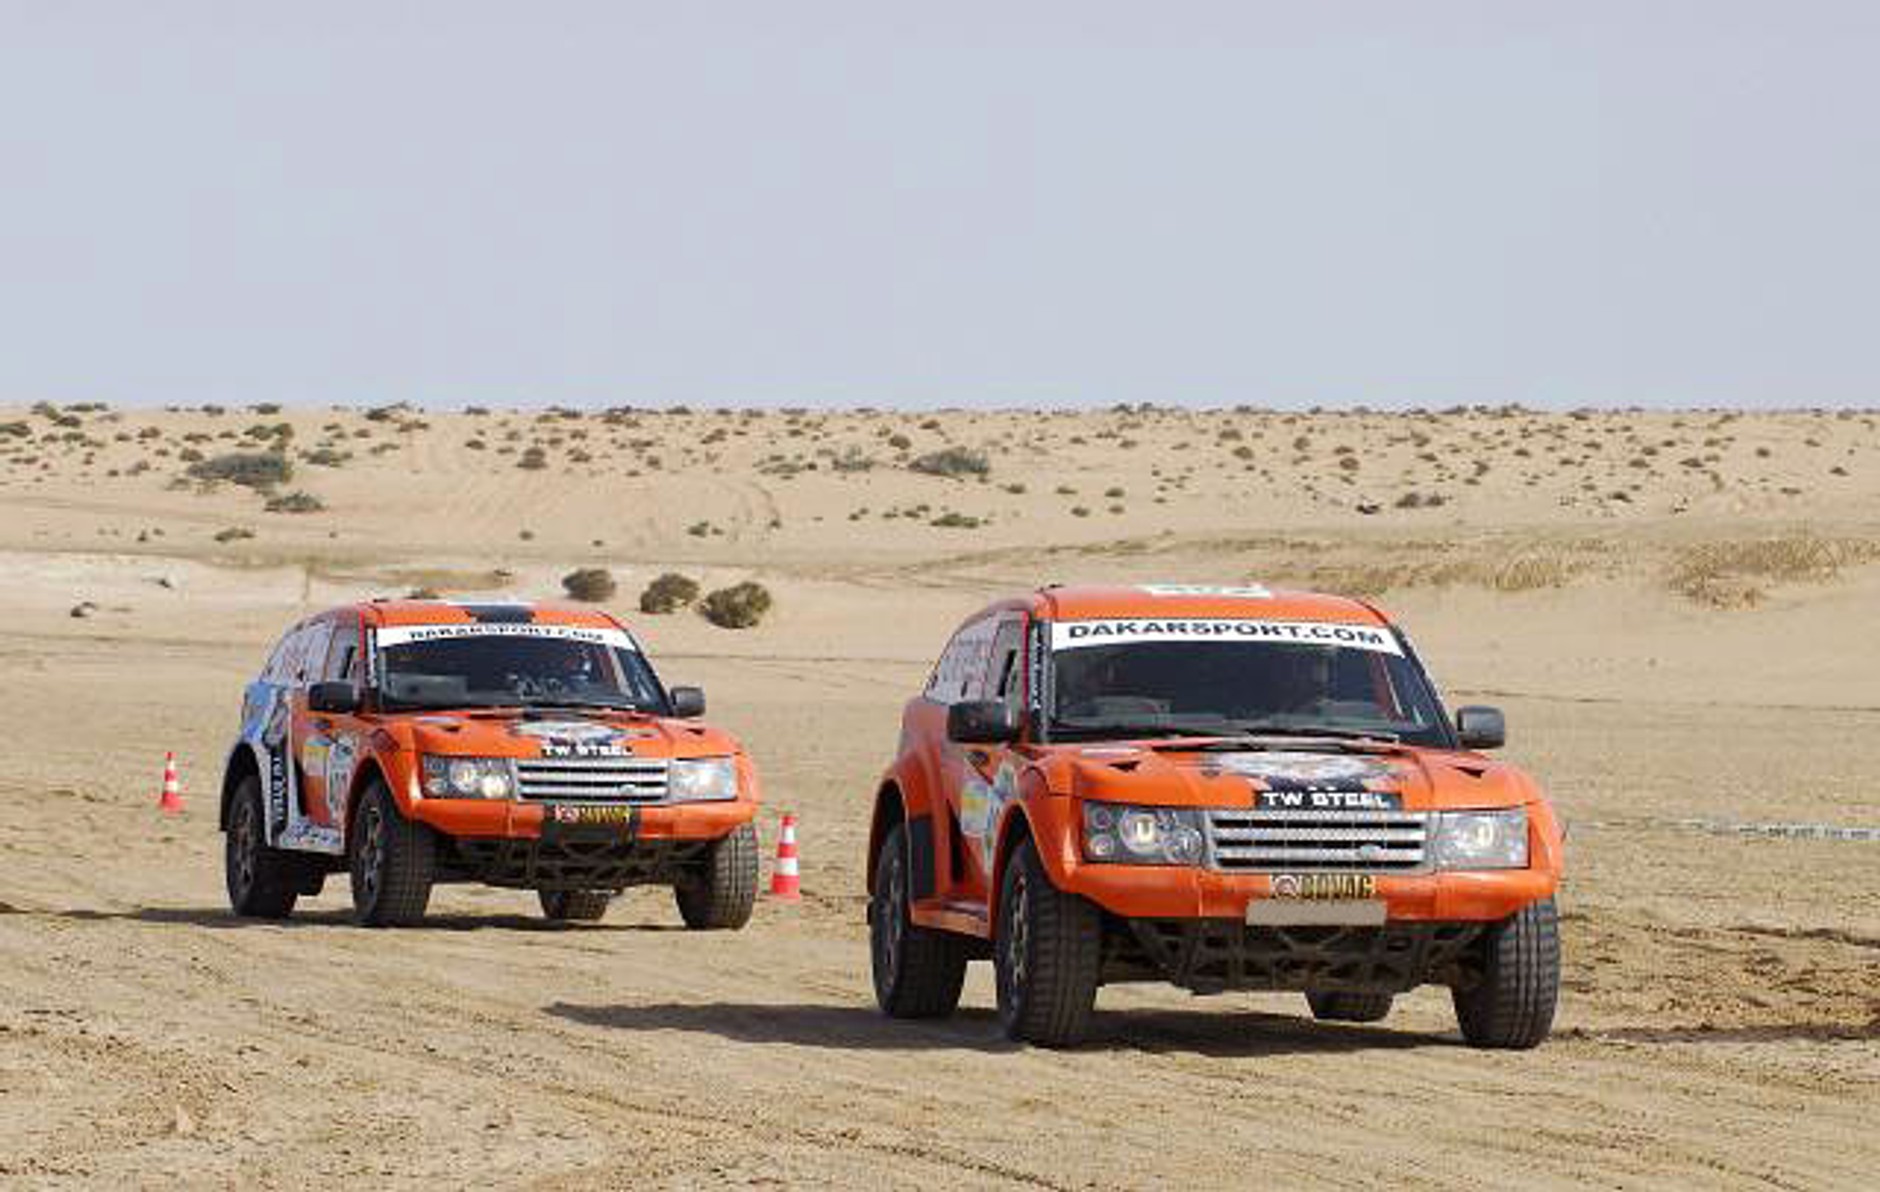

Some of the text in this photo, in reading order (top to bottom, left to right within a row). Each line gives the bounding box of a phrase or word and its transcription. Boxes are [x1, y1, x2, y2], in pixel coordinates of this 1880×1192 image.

[1068, 621, 1384, 646] DAKARSPORT.COM
[1263, 792, 1390, 808] TW STEEL
